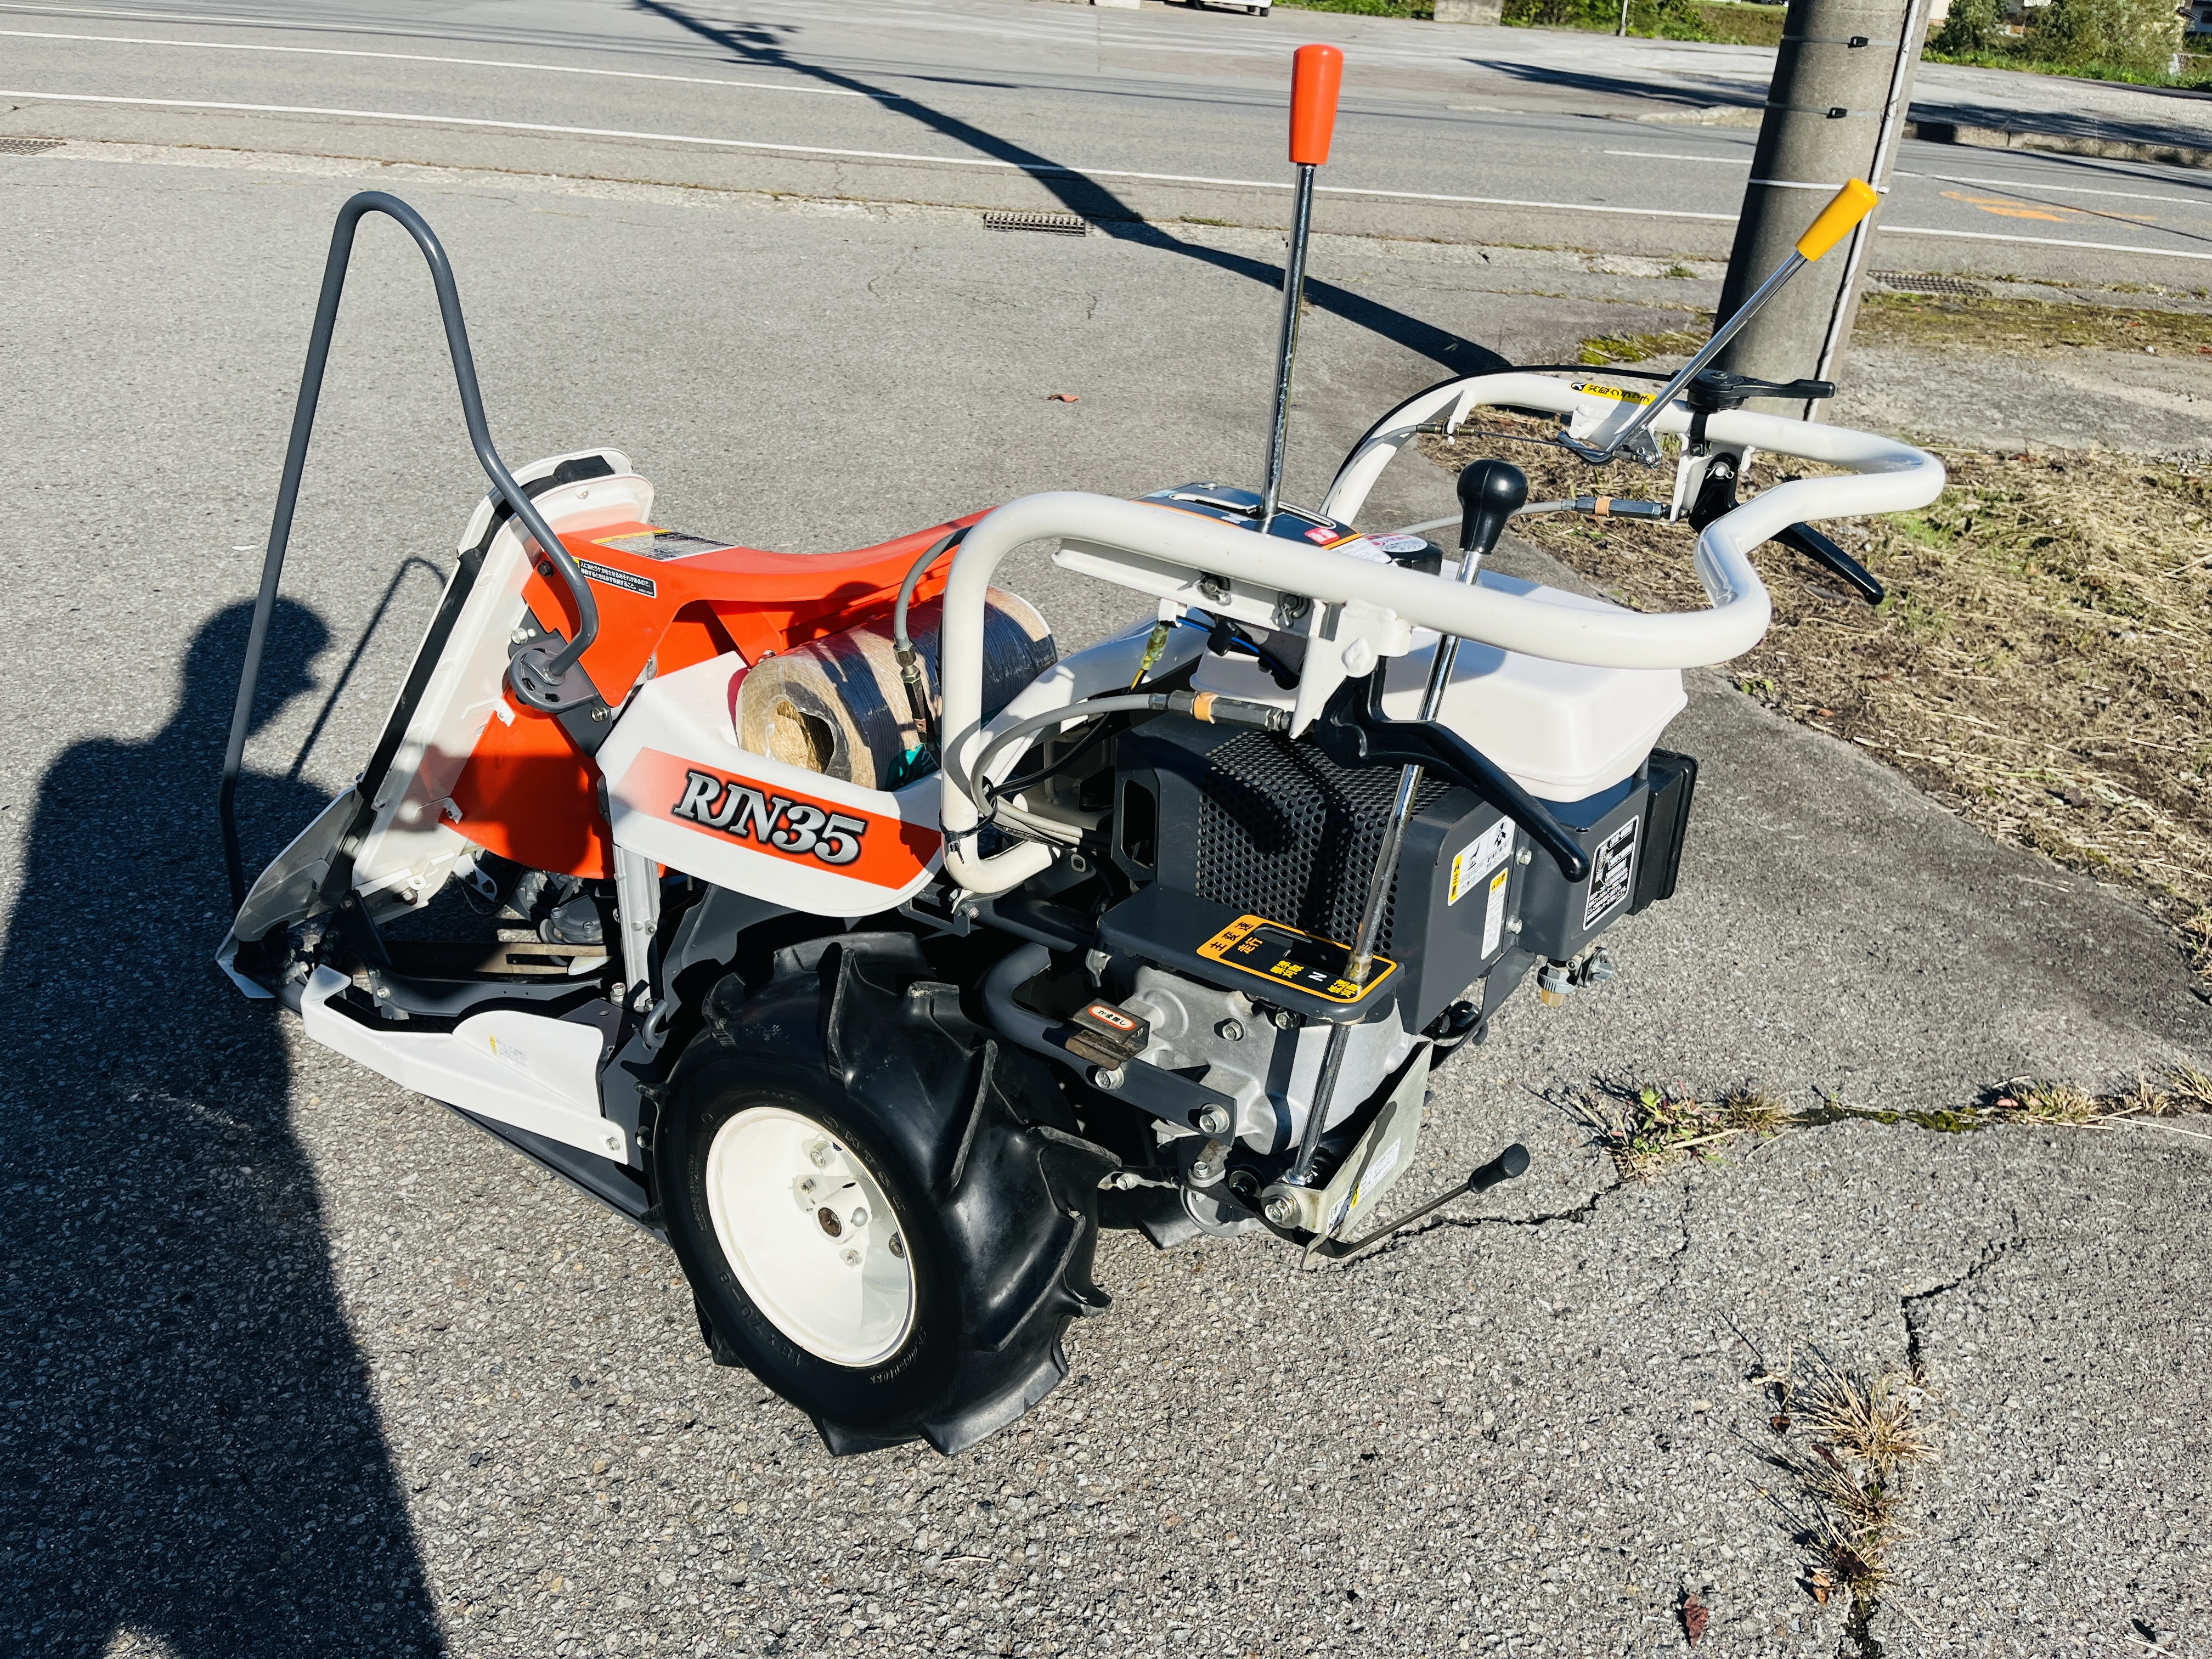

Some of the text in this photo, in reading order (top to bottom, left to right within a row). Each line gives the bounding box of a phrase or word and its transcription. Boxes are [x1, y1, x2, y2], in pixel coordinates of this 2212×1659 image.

[1588, 385, 1650, 402] 刈取クラッチ
[673, 769, 867, 865] RJN35
[1210, 922, 1254, 951] 主変速
[1237, 936, 1263, 954] 走行
[1307, 971, 1328, 982] N
